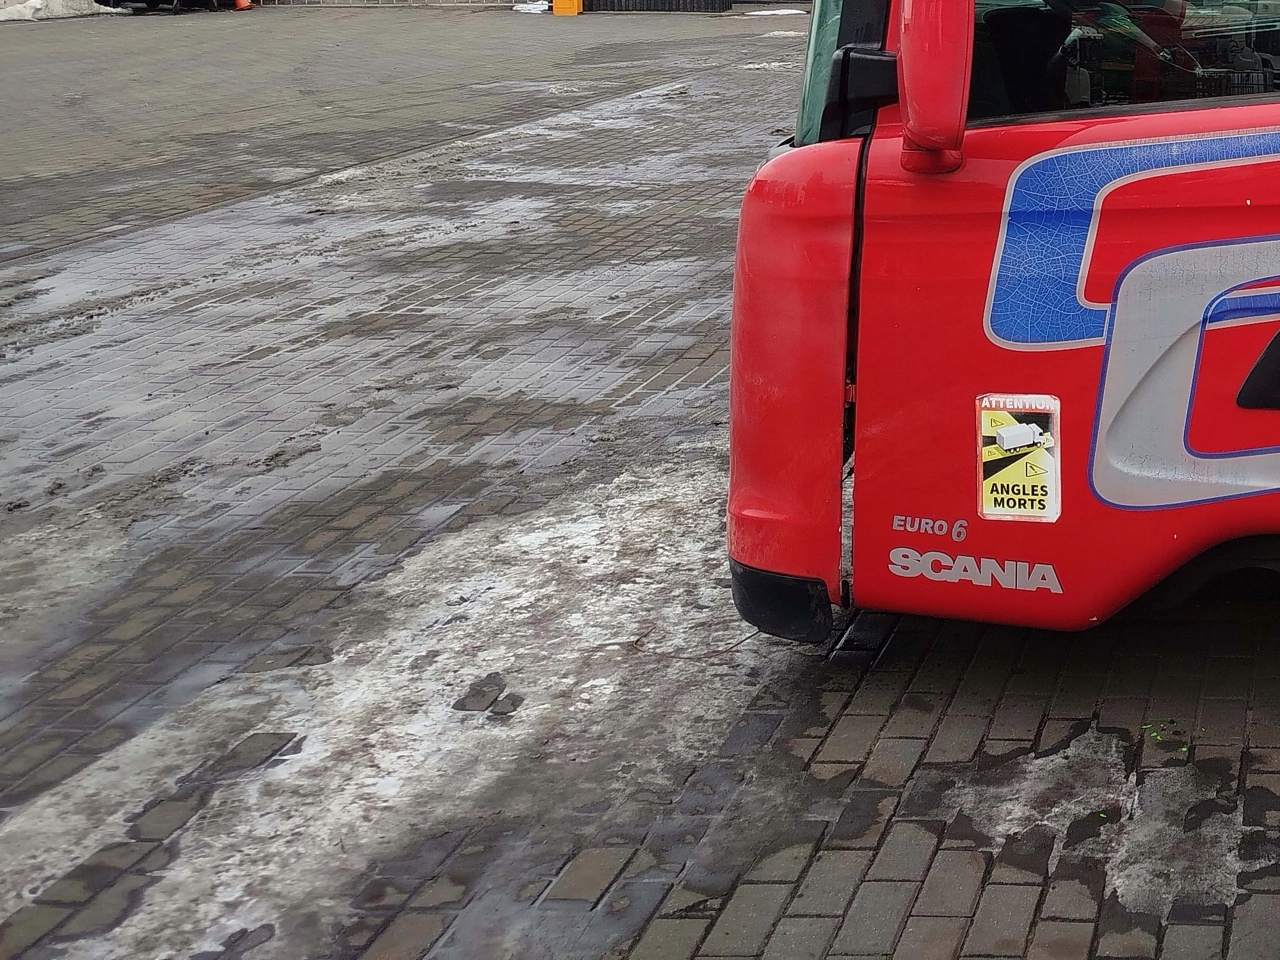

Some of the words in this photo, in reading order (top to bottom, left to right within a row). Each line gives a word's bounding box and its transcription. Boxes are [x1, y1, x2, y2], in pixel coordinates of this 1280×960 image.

[981, 397, 1055, 410] ATTENTION
[989, 482, 1049, 497] ANGLES
[993, 496, 1047, 511] MORTS
[892, 515, 948, 536] EURO
[951, 519, 969, 542] 6
[888, 547, 1064, 594] SCANIA
